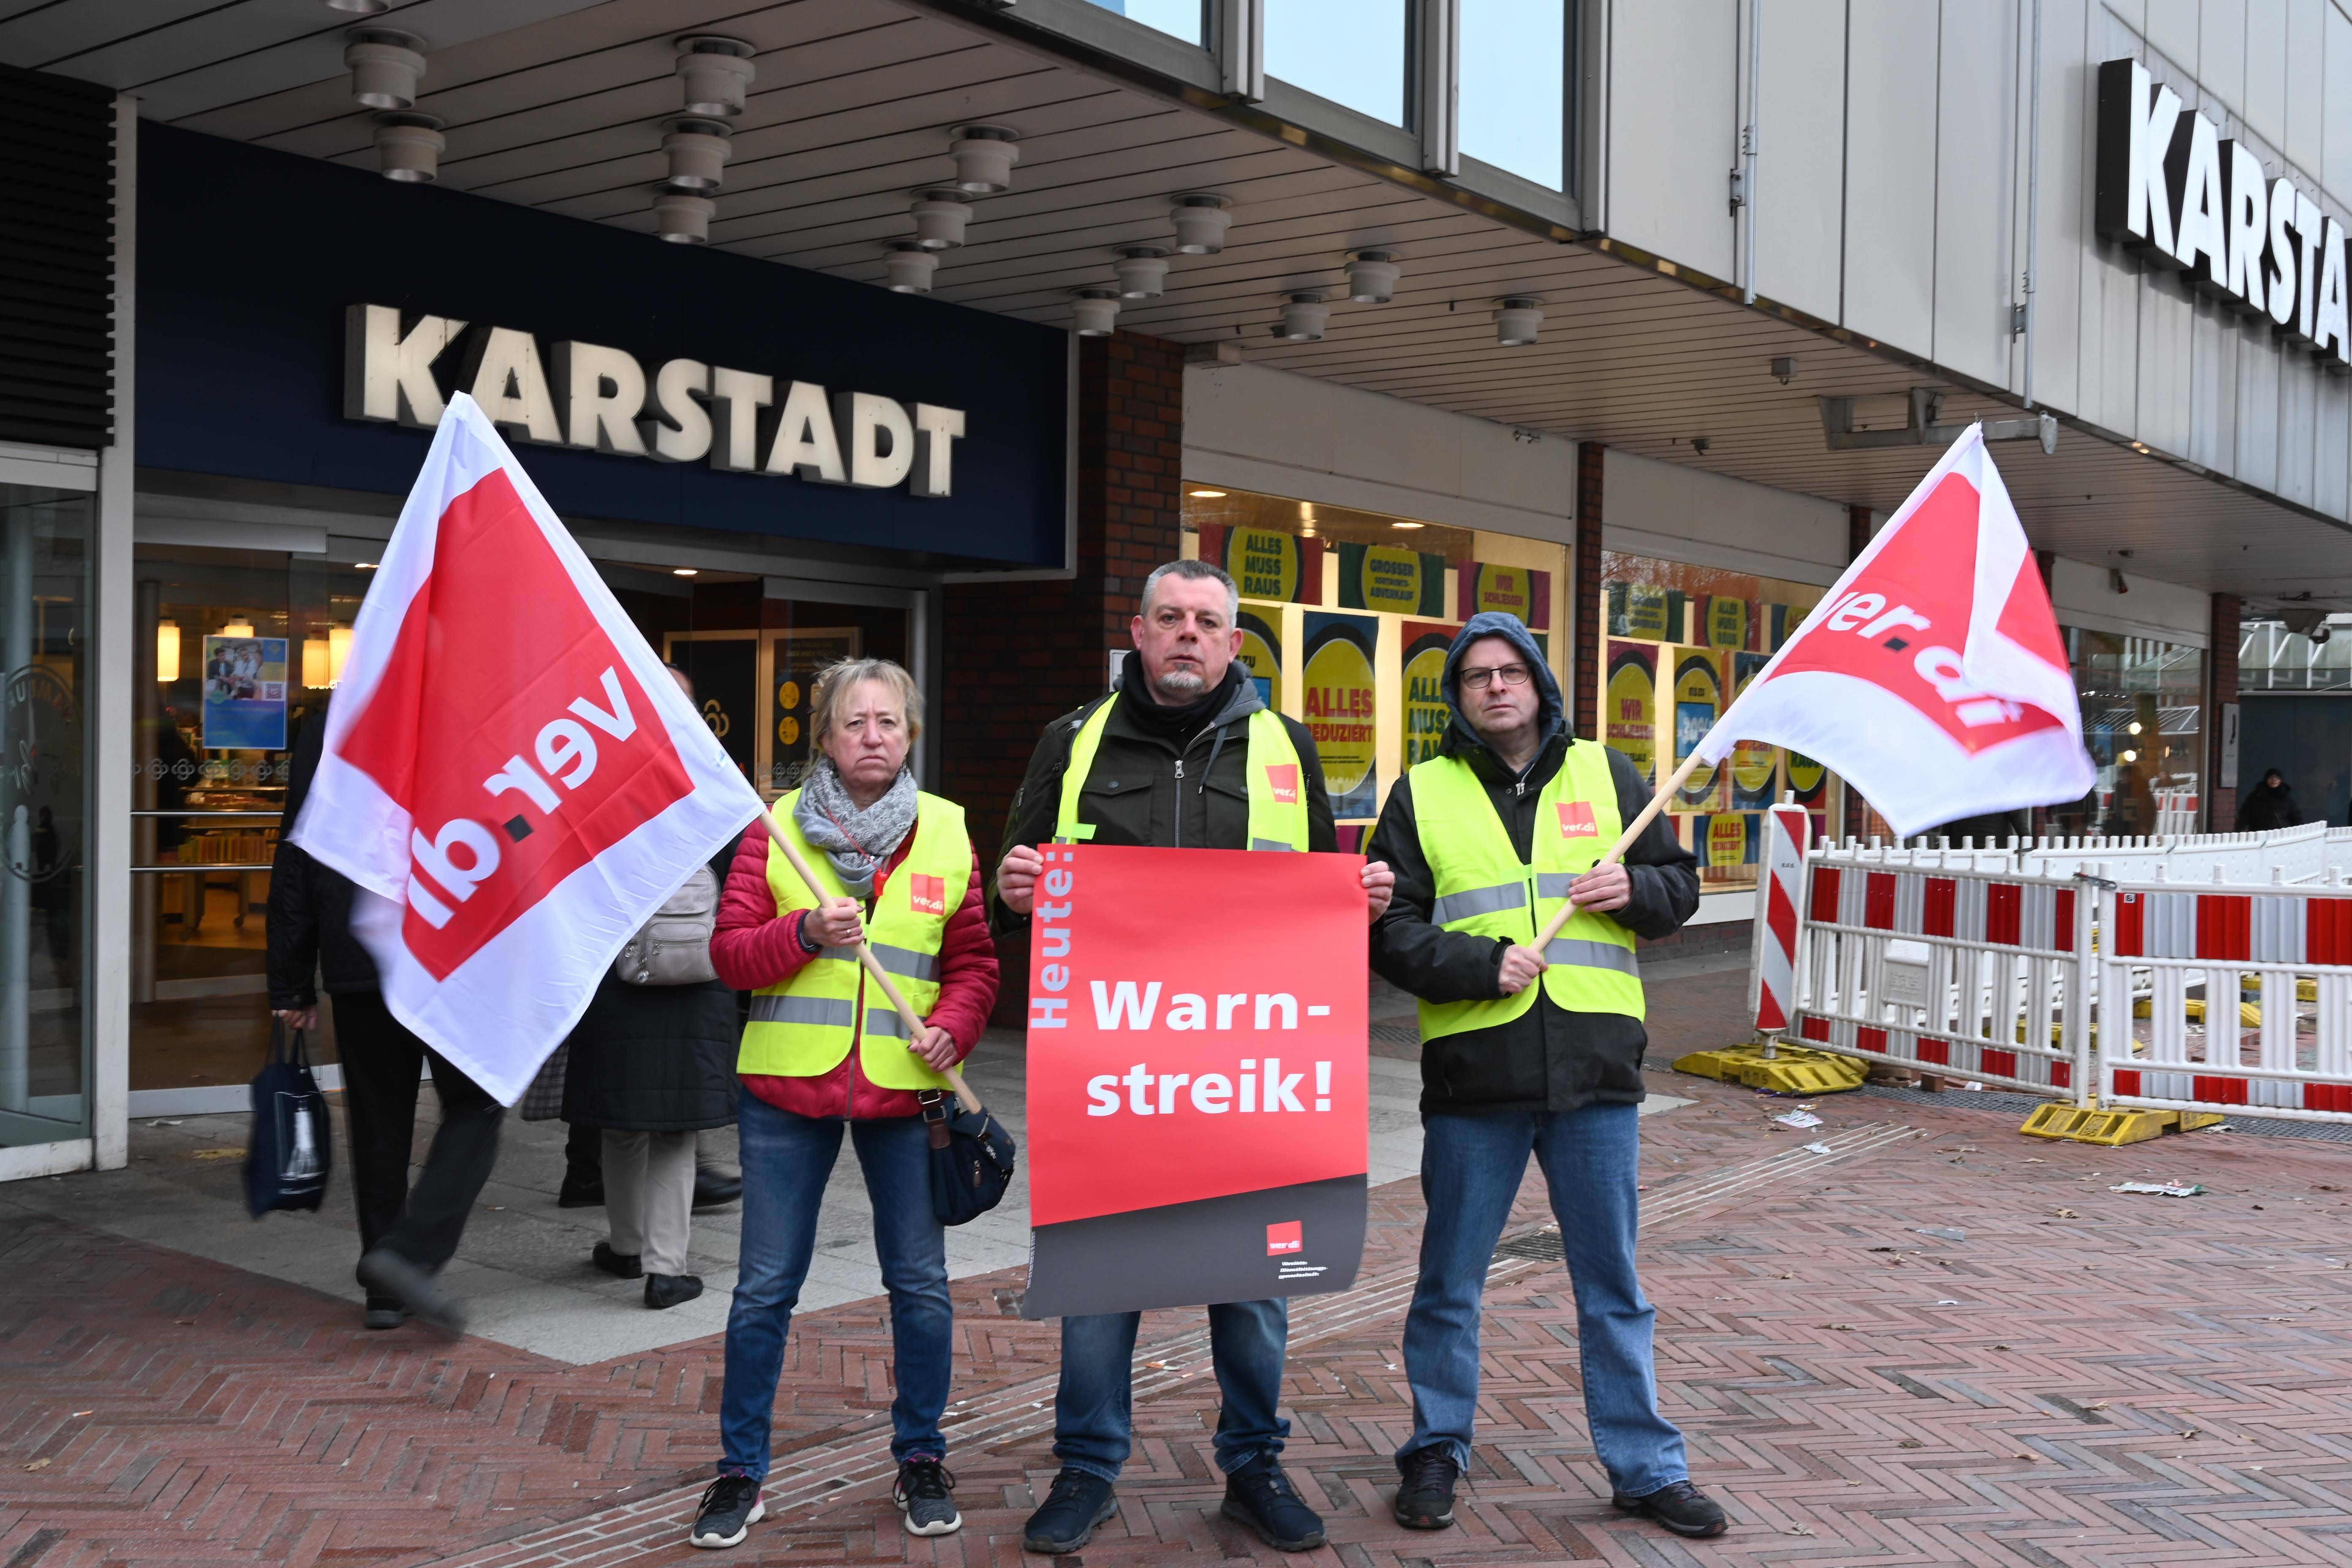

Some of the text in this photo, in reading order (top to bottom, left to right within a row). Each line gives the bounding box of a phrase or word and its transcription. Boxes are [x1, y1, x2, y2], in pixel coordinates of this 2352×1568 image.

[2125, 57, 2352, 365] KARSTA
[359, 302, 966, 498] KARSTADT
[1246, 534, 1282, 555] ALLES
[1245, 555, 1281, 576] MUSS
[1370, 559, 1414, 577] GROSSER
[1244, 576, 1281, 596] RAUS
[1495, 574, 1514, 592] WIR
[1408, 677, 1447, 703] ALL
[1304, 687, 1373, 719] ALLES
[1621, 699, 1642, 721] WIR
[1407, 708, 1451, 734] MUS
[1561, 822, 1595, 832] ver.di
[1713, 822, 1741, 838] ALLES
[912, 895, 944, 911] ver.di
[1030, 851, 1073, 1029] Heute:
[1090, 980, 1331, 1031] Warn-
[1086, 1058, 1332, 1117] streik!
